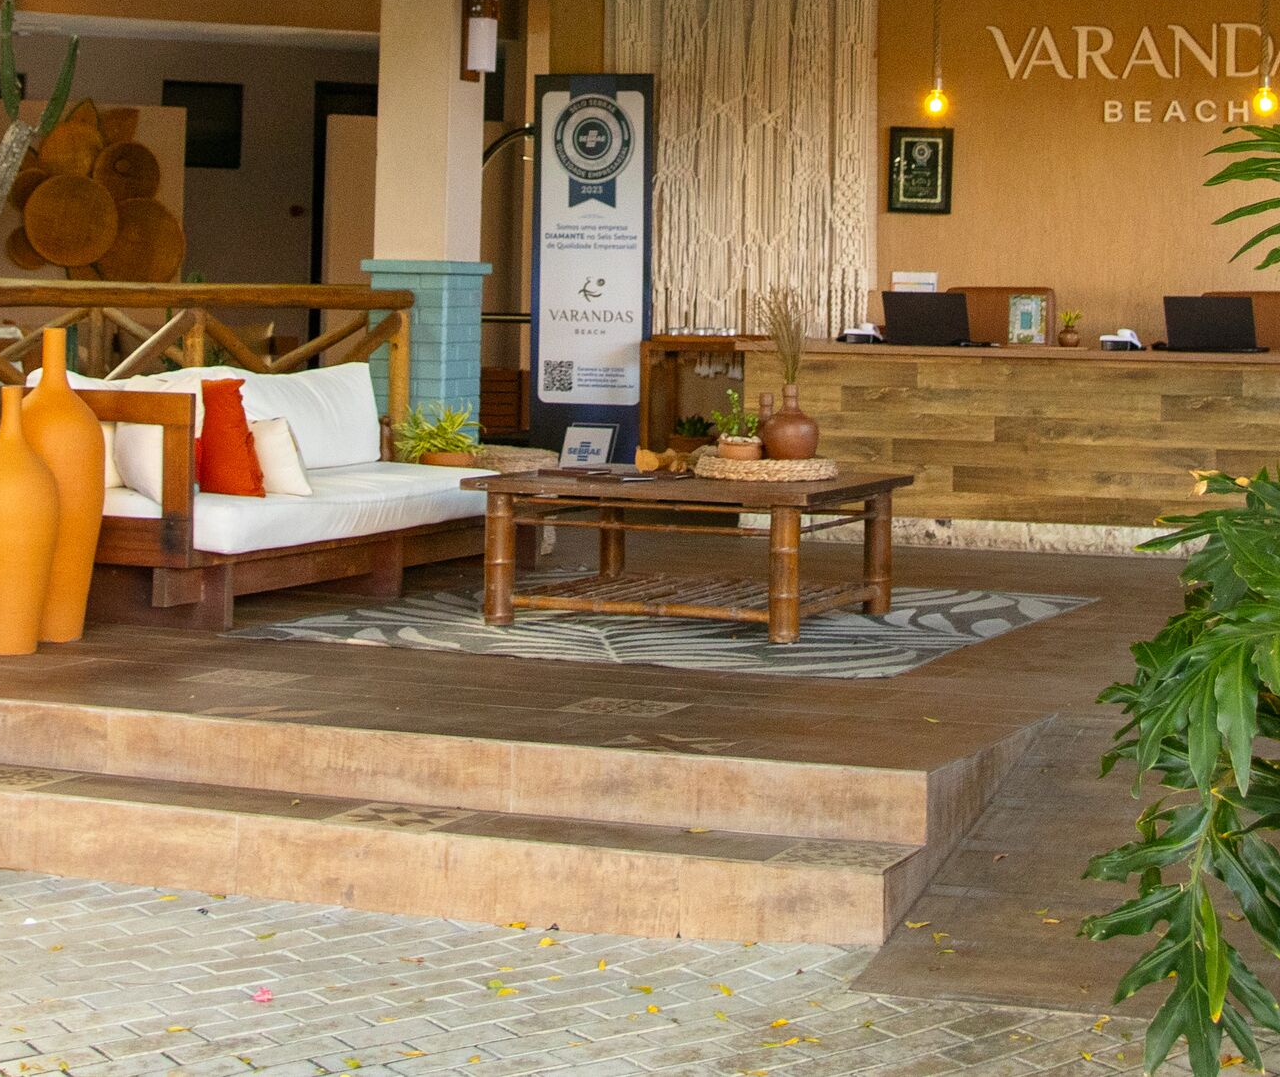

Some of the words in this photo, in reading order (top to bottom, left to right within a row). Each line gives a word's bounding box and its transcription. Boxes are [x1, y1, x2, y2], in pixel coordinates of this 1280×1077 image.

[1104, 100, 1249, 123] BEACH
[544, 232, 585, 240] DIAMANTE
[549, 308, 634, 323] VARANDAS
[568, 447, 601, 455] SEBRAE
